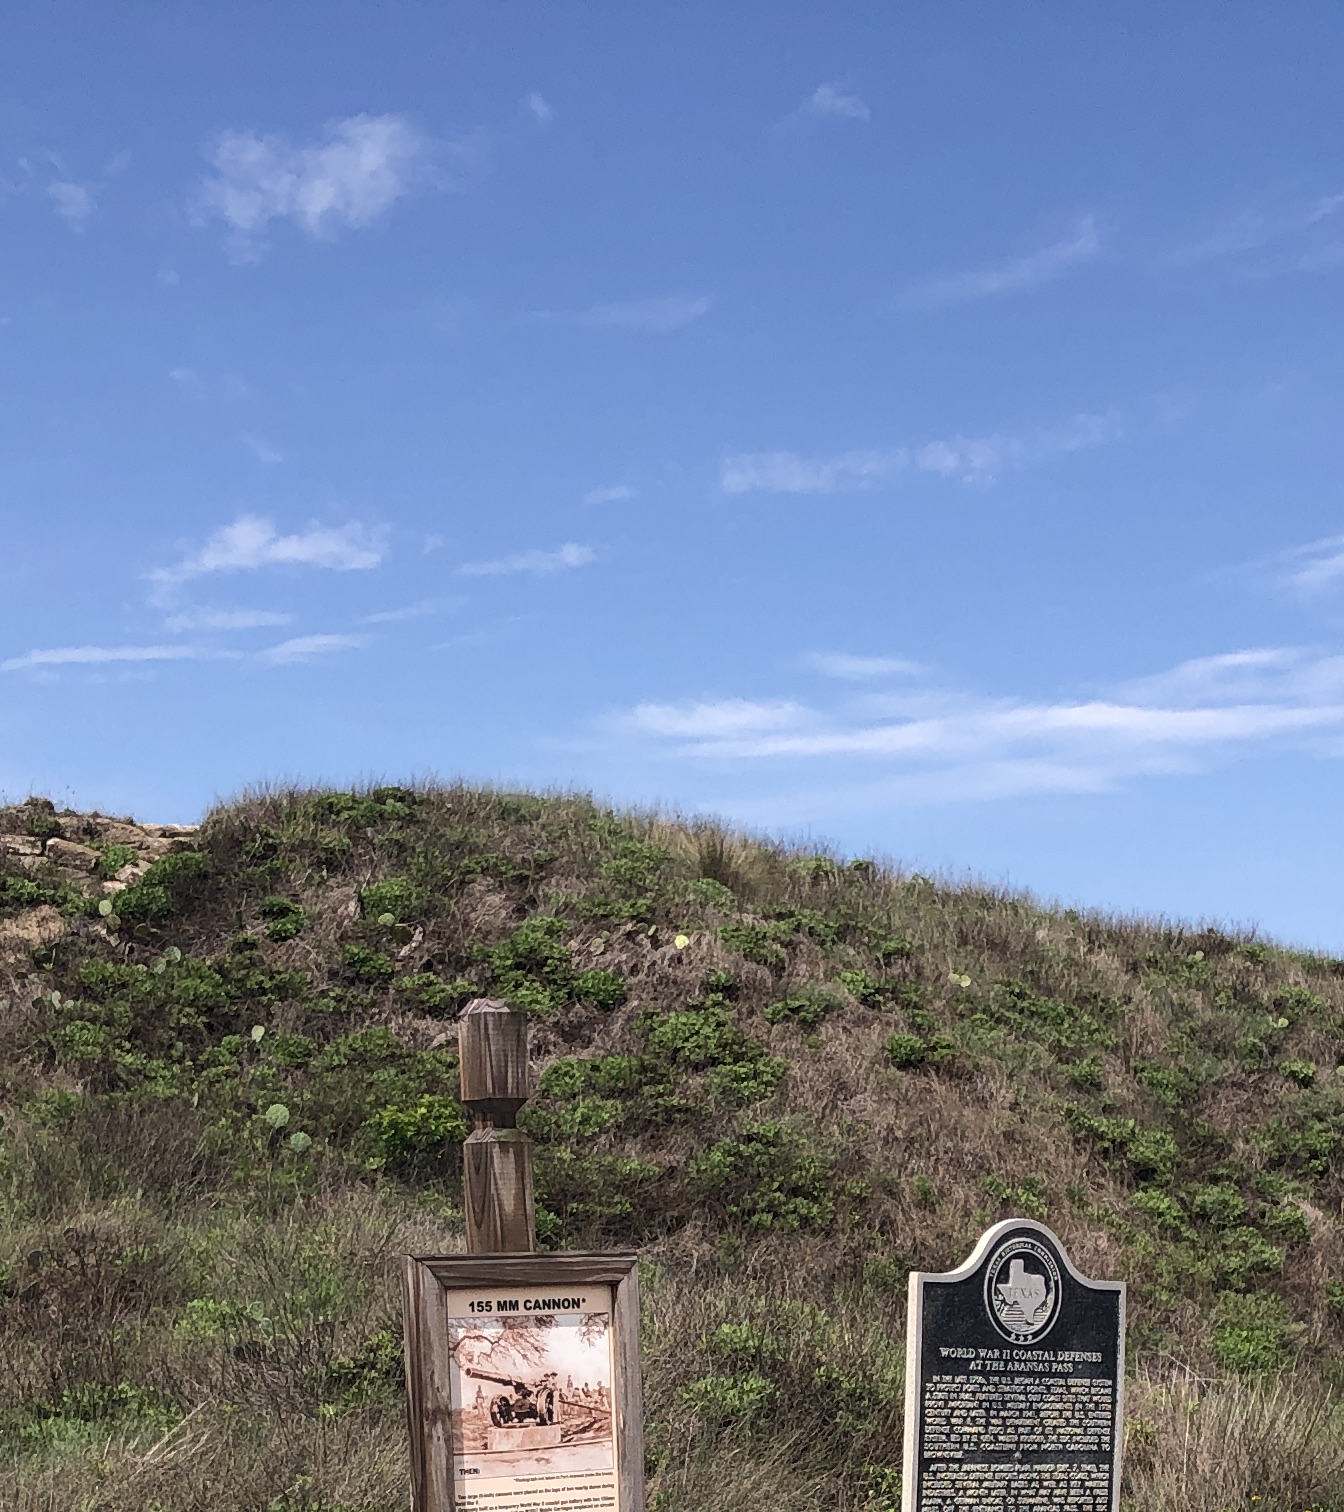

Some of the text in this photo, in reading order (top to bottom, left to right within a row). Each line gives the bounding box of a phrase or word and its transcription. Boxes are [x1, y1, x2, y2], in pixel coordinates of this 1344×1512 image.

[1008, 1288, 1039, 1299] TEXAS
[469, 1301, 492, 1313] 155
[497, 1300, 519, 1311] MM
[939, 1347, 1102, 1362] WORLD WAR II COASTAL DEFENSES
[969, 1360, 1074, 1372] AT THE ARANSAS PASS
